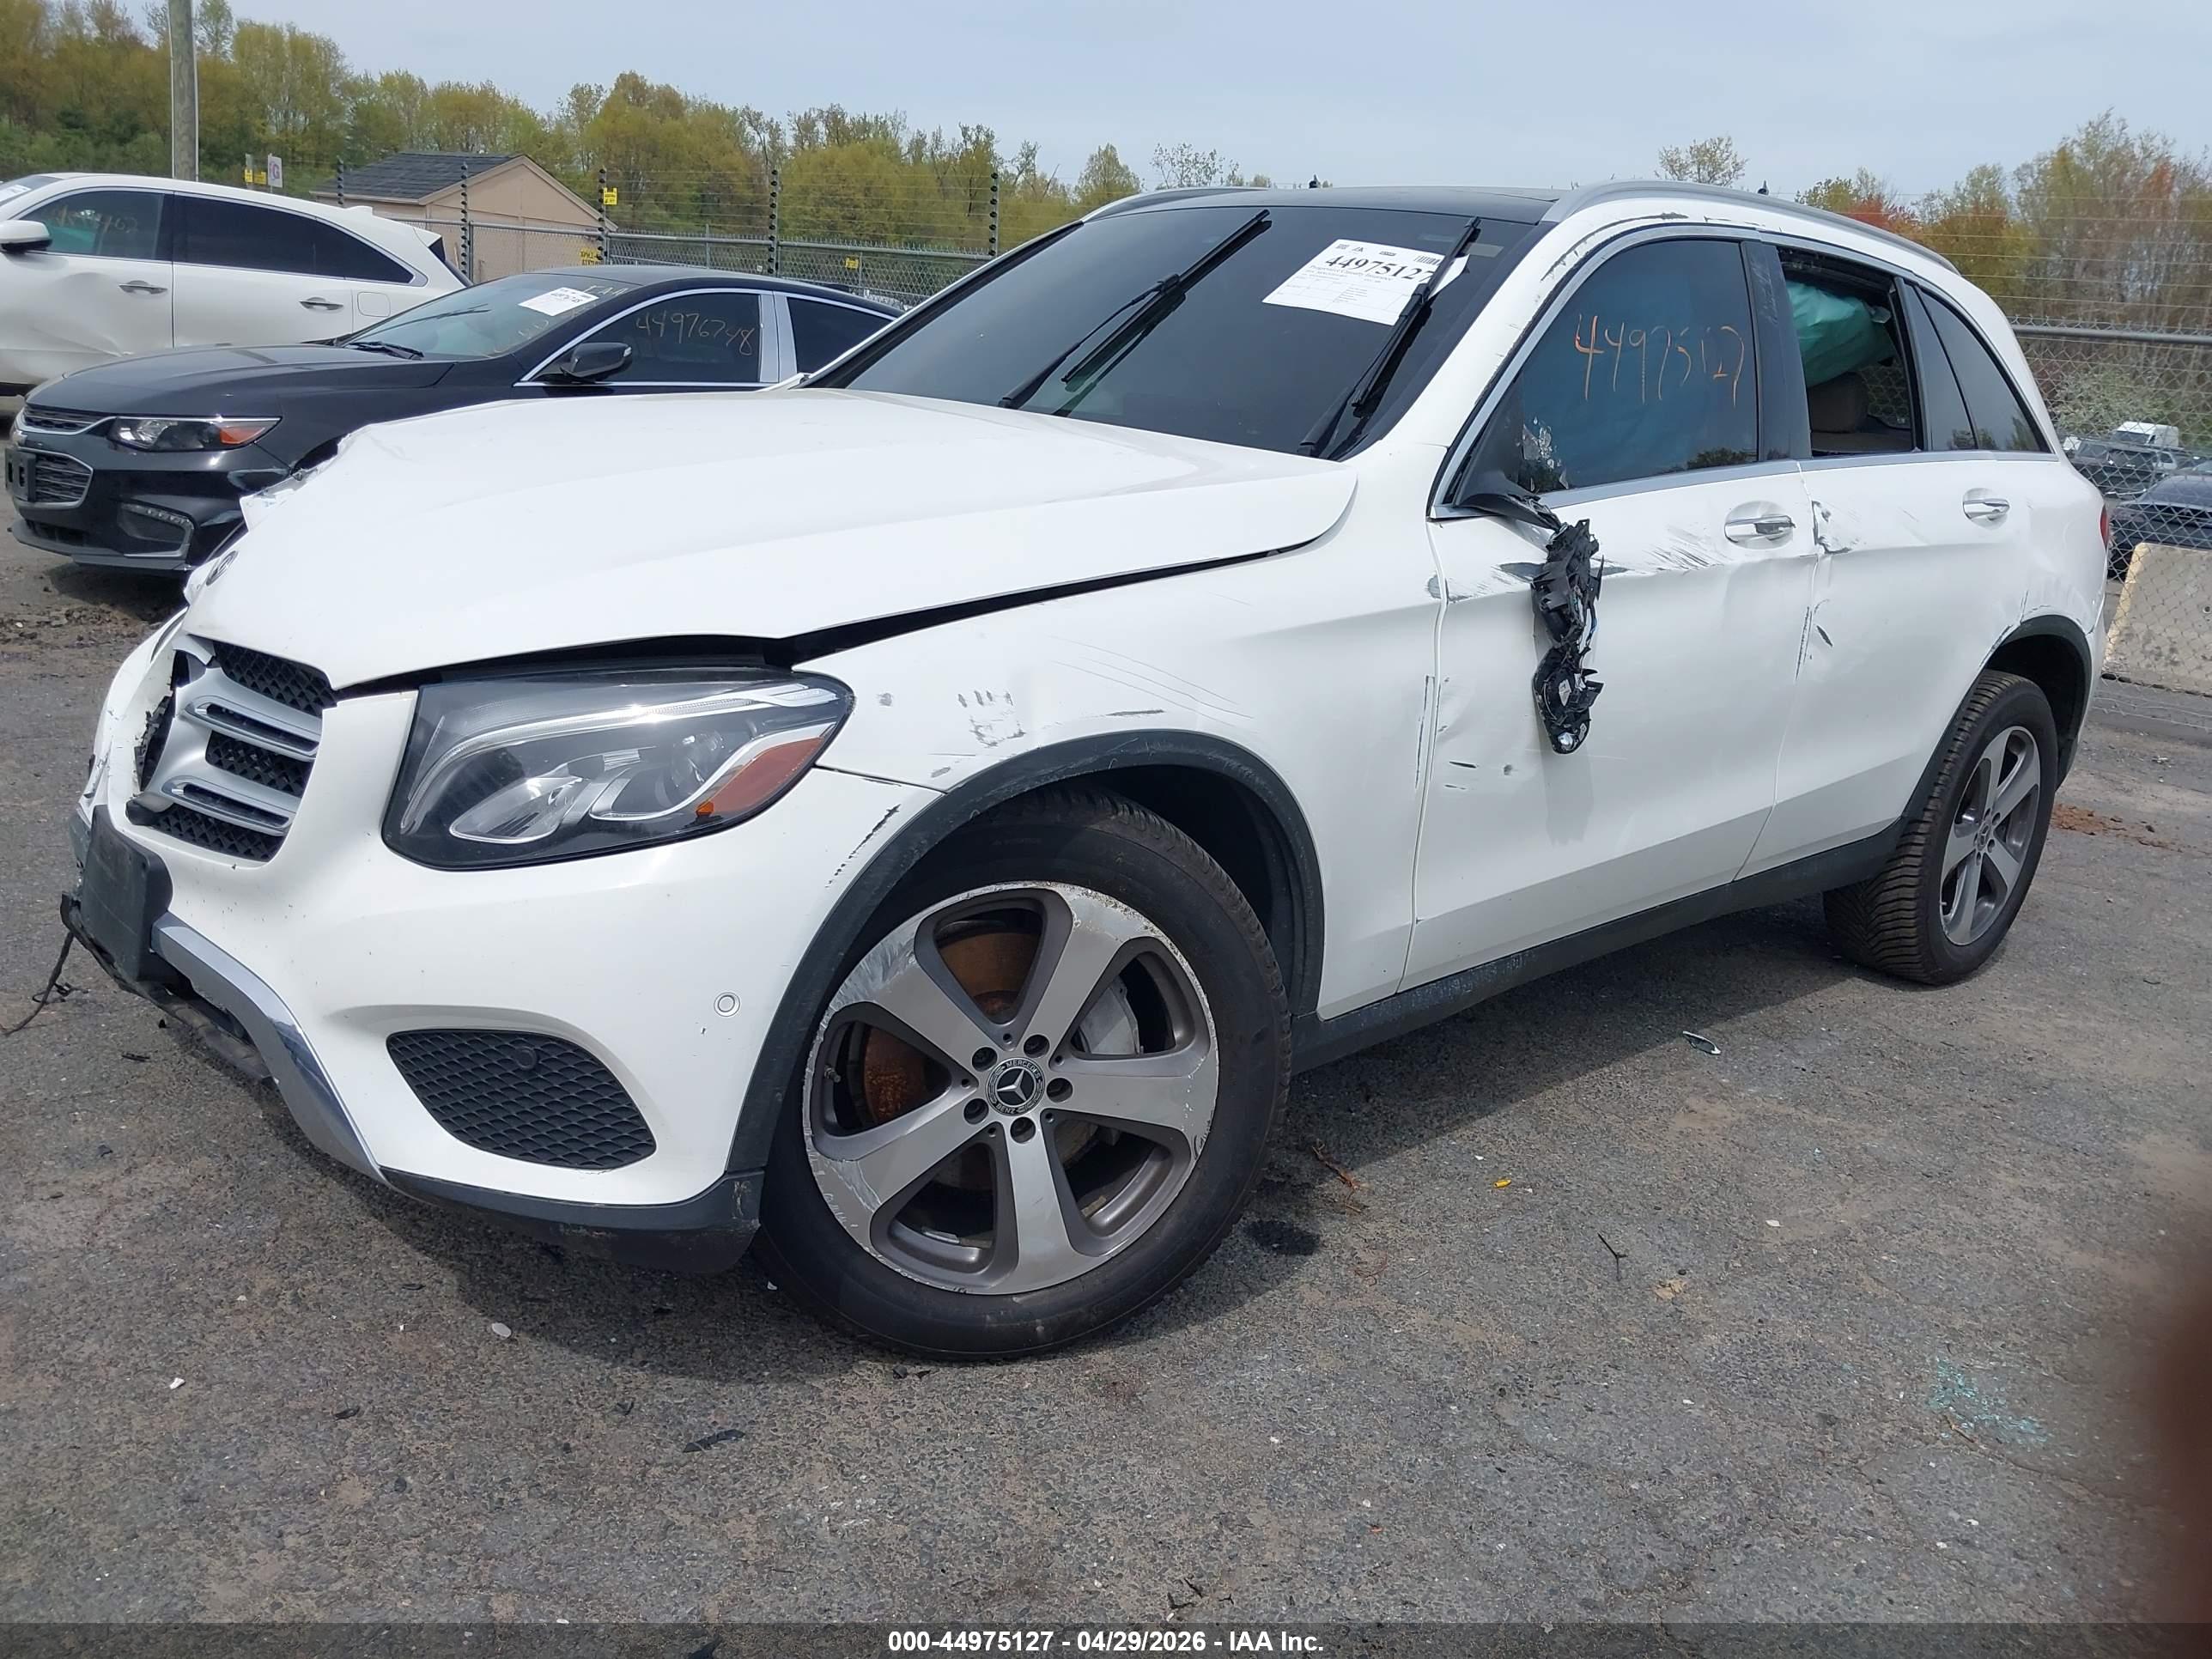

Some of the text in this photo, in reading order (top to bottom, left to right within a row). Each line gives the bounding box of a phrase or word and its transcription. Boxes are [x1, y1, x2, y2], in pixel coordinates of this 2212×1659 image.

[1325, 255, 1435, 283] 44975127
[636, 310, 756, 356] 44976748
[1005, 1060, 1042, 1079] MERCEDES
[996, 1103, 1017, 1115] BENZ
